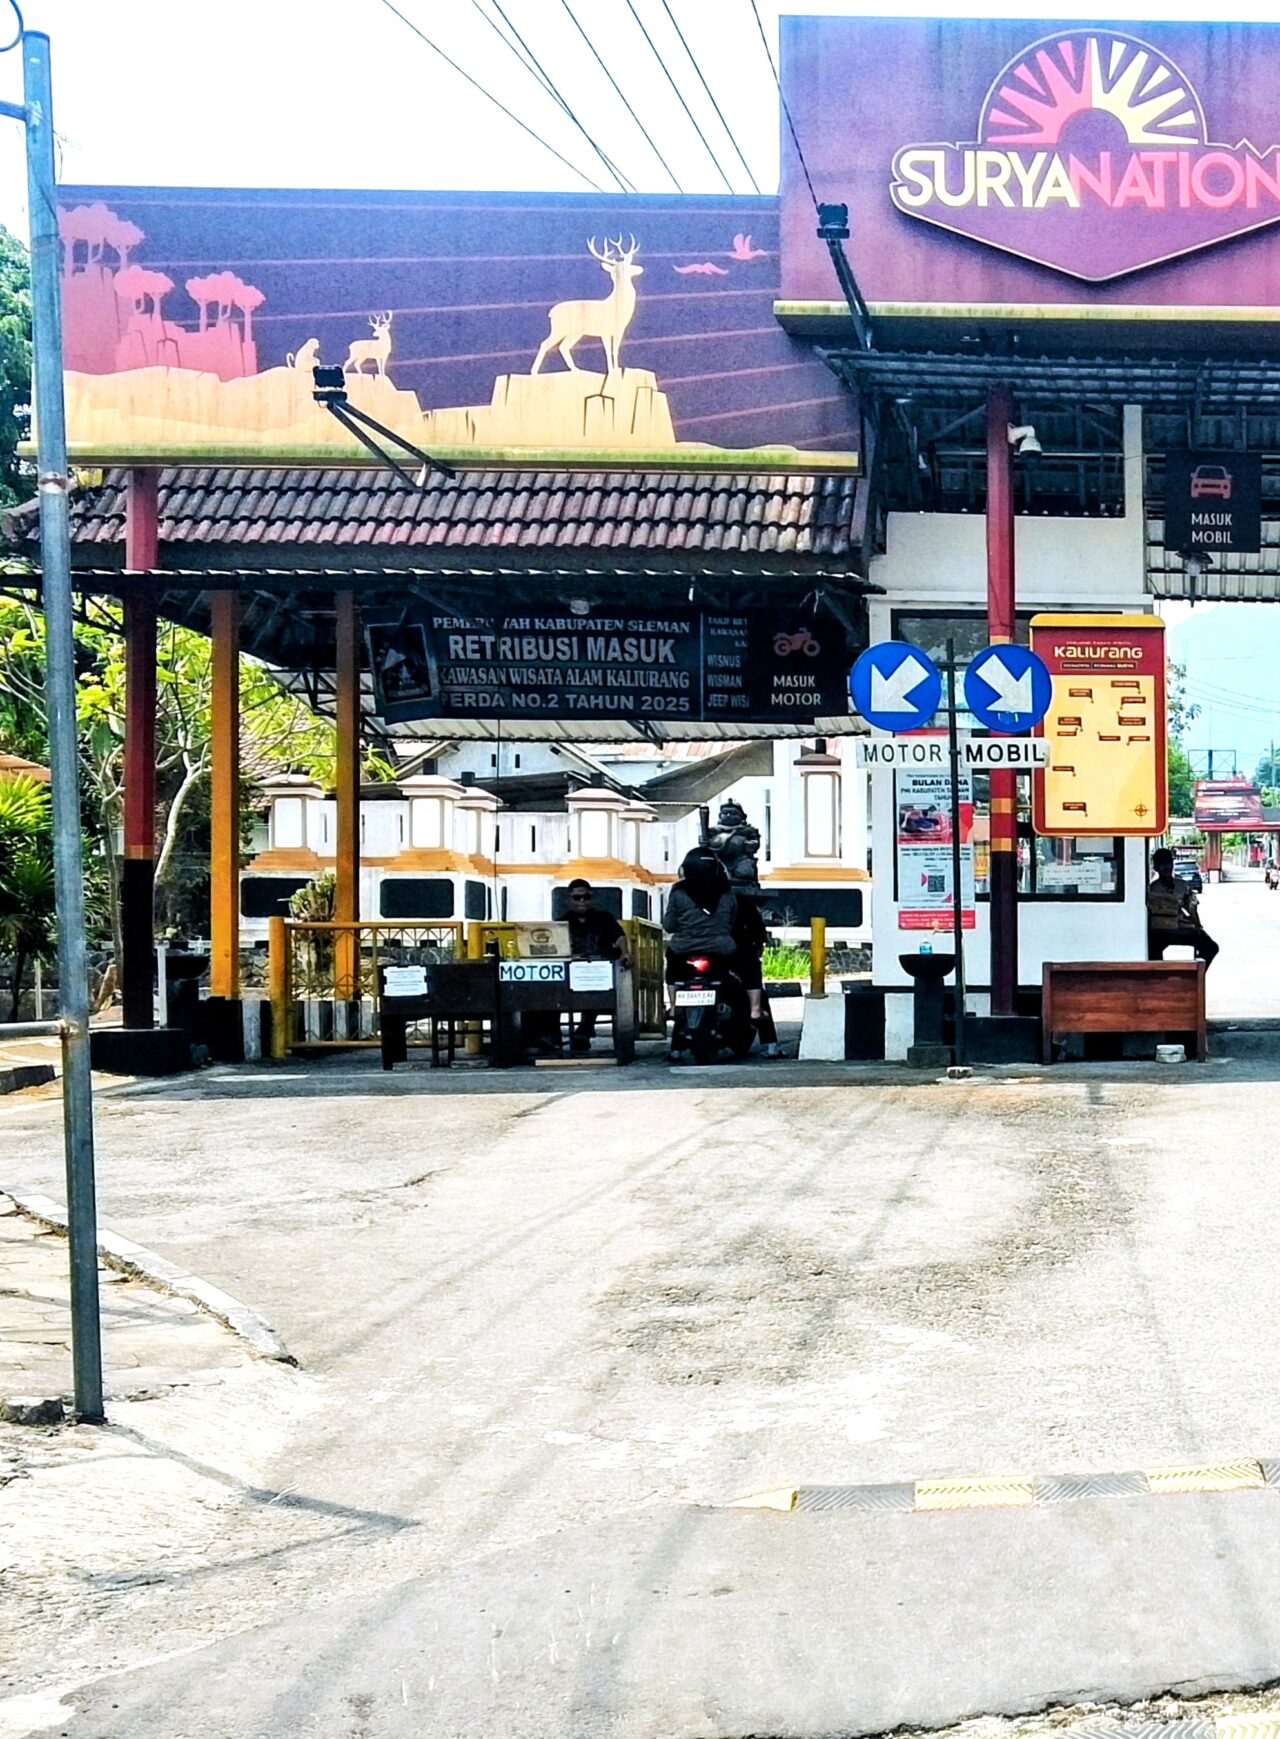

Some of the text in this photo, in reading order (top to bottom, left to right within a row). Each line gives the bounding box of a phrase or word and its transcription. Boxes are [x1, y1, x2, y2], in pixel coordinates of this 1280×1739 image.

[1191, 513, 1232, 526] MASUK
[1191, 531, 1233, 544] MOBIL
[534, 617, 624, 631] KABUPATEN
[627, 619, 690, 633] SLEMAN
[449, 634, 676, 663] RETRIBUSI MASUK
[706, 654, 741, 668] WISNUS
[508, 667, 563, 686] WISATA
[565, 668, 603, 687] ALAM
[606, 669, 690, 688] KALIURANG
[706, 673, 742, 688] WISMAN
[773, 674, 816, 688] MASUK
[512, 692, 559, 709] NO.2
[565, 694, 634, 710] TAHUN
[640, 695, 690, 711] 2025
[707, 693, 729, 708] JEEP
[771, 692, 821, 706] MOTOR
[863, 743, 1046, 763] MOTOR MOBIL
[500, 964, 564, 980] MOTOR
